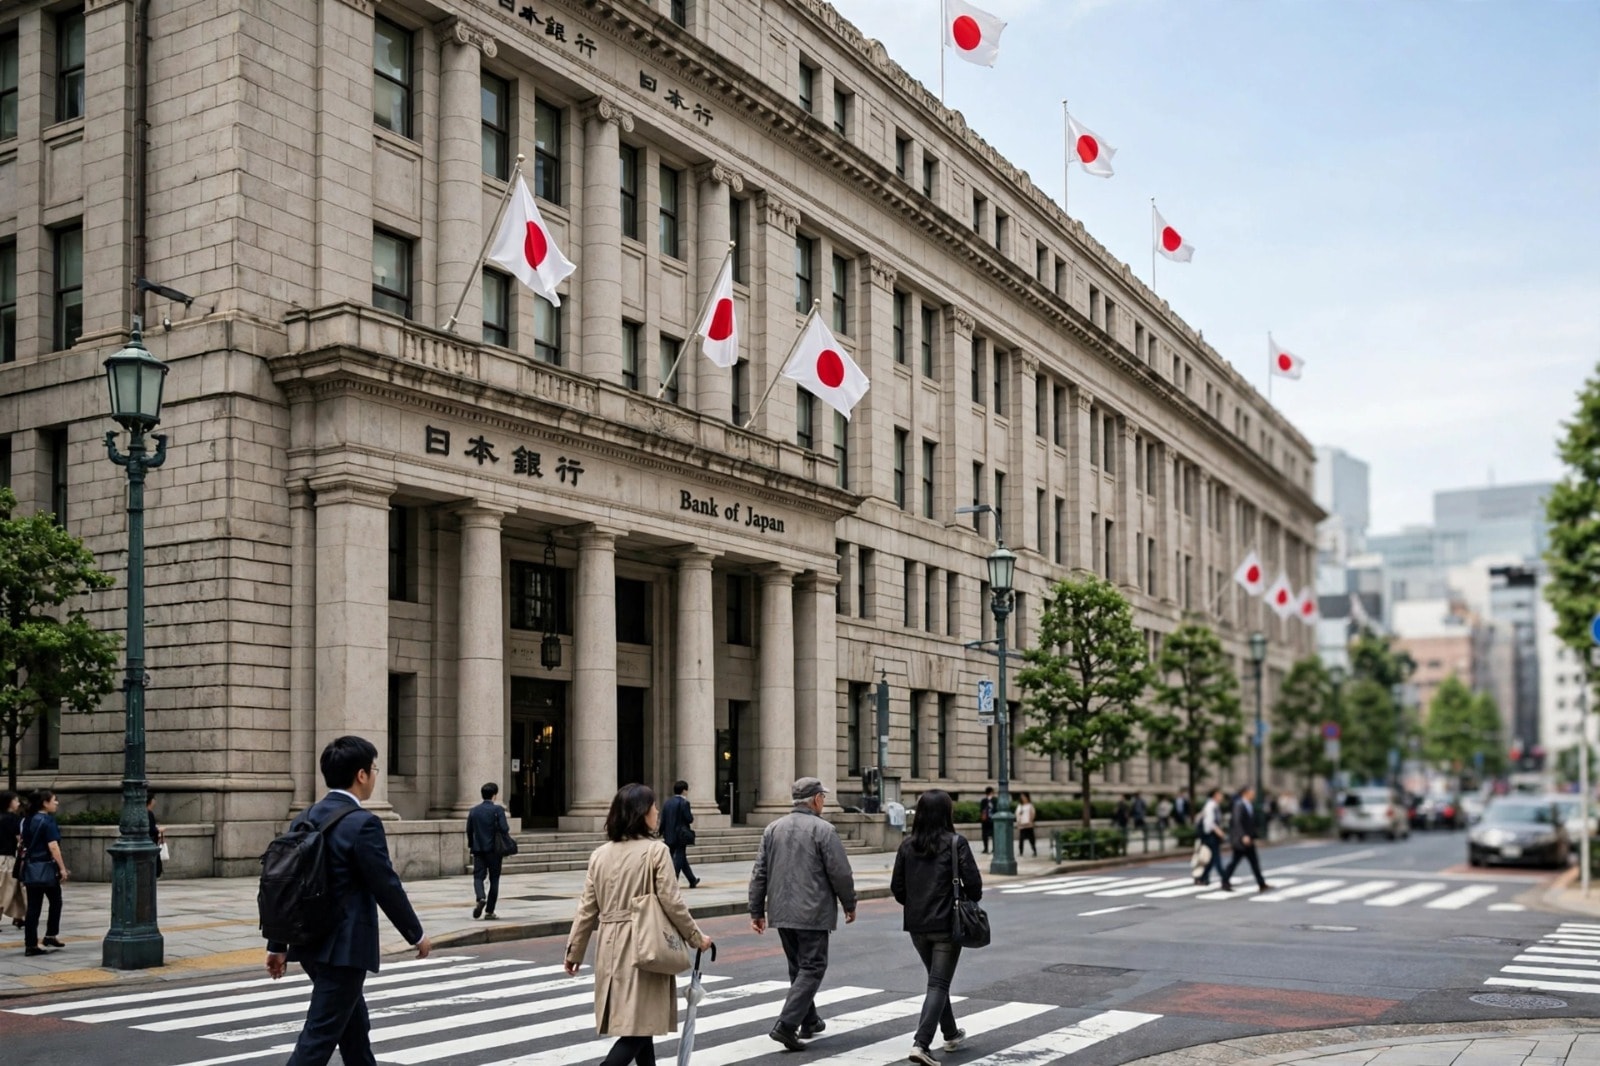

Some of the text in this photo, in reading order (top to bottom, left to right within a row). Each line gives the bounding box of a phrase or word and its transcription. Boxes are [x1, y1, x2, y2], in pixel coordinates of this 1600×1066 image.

[639, 70, 714, 126] 日本行
[425, 424, 584, 487] 日本銀行
[680, 489, 785, 533] Bank of Japan
